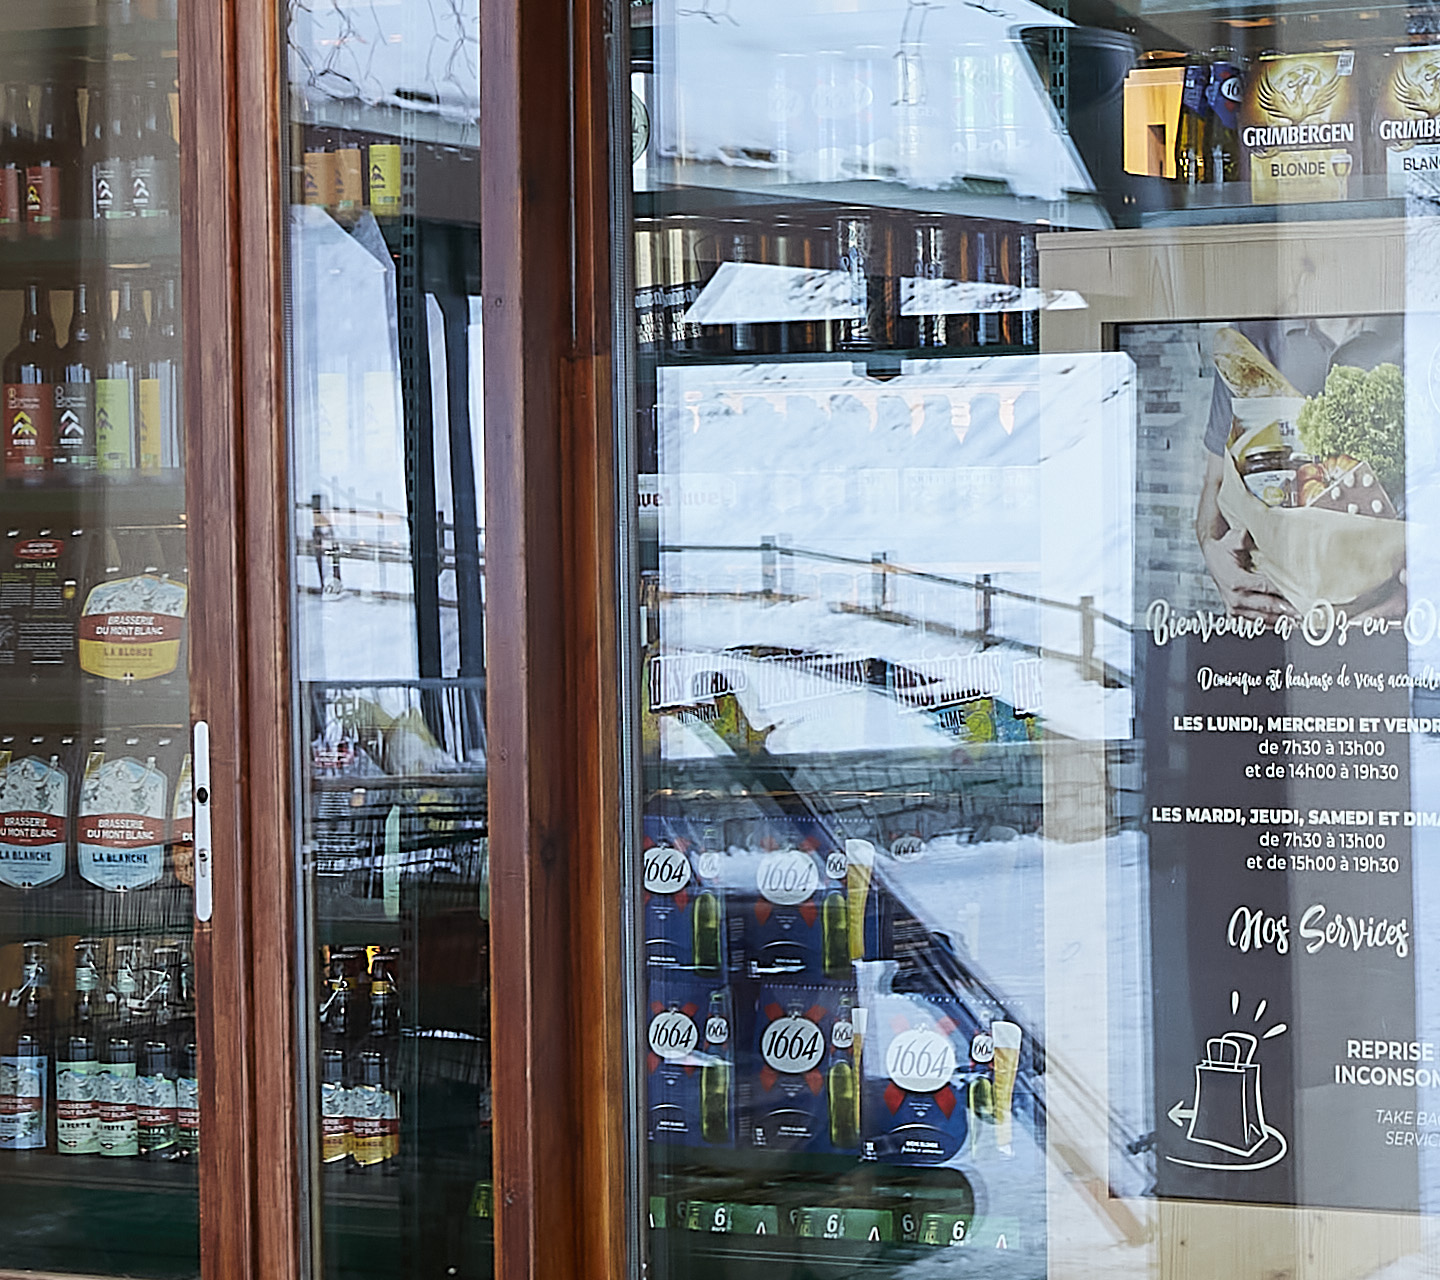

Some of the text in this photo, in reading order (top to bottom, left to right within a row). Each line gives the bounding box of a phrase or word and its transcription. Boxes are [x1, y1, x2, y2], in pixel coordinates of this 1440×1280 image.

[1243, 122, 1355, 148] GRIMBERGEN
[1271, 161, 1326, 178] BLONDE
[1198, 667, 1262, 695] Dominique
[1266, 669, 1282, 690] est
[1285, 664, 1333, 691] heureuse
[1337, 664, 1350, 688] de
[1174, 716, 1203, 732] LES
[1207, 716, 1263, 734] LUNDI,
[1267, 717, 1354, 733] MERCREDI
[1359, 718, 1380, 733] ET
[1258, 739, 1385, 756] de 7h30 à 13h00
[1245, 763, 1399, 780] et de 14h00 à 19h30
[98, 819, 144, 829] BRASSERIE
[1152, 807, 1182, 823] LES
[1185, 807, 1246, 826] MARDI,
[1249, 809, 1304, 827] JEUDI,
[1308, 810, 1373, 826] SAMEDI
[1378, 811, 1400, 827] ET
[87, 829, 155, 840] DU MONT BLANC
[1259, 831, 1386, 849] de 7h30 à 13h00
[1246, 855, 1400, 873] et de 15h00 à 19h30
[762, 863, 813, 892] 1664
[1228, 903, 1409, 958] Nos Services
[652, 1022, 694, 1047] 1664
[766, 1030, 820, 1060] 1664
[1347, 1040, 1435, 1062] REPRISE
[891, 1048, 949, 1078] 1664
[1375, 1109, 1414, 1125] TAKE
